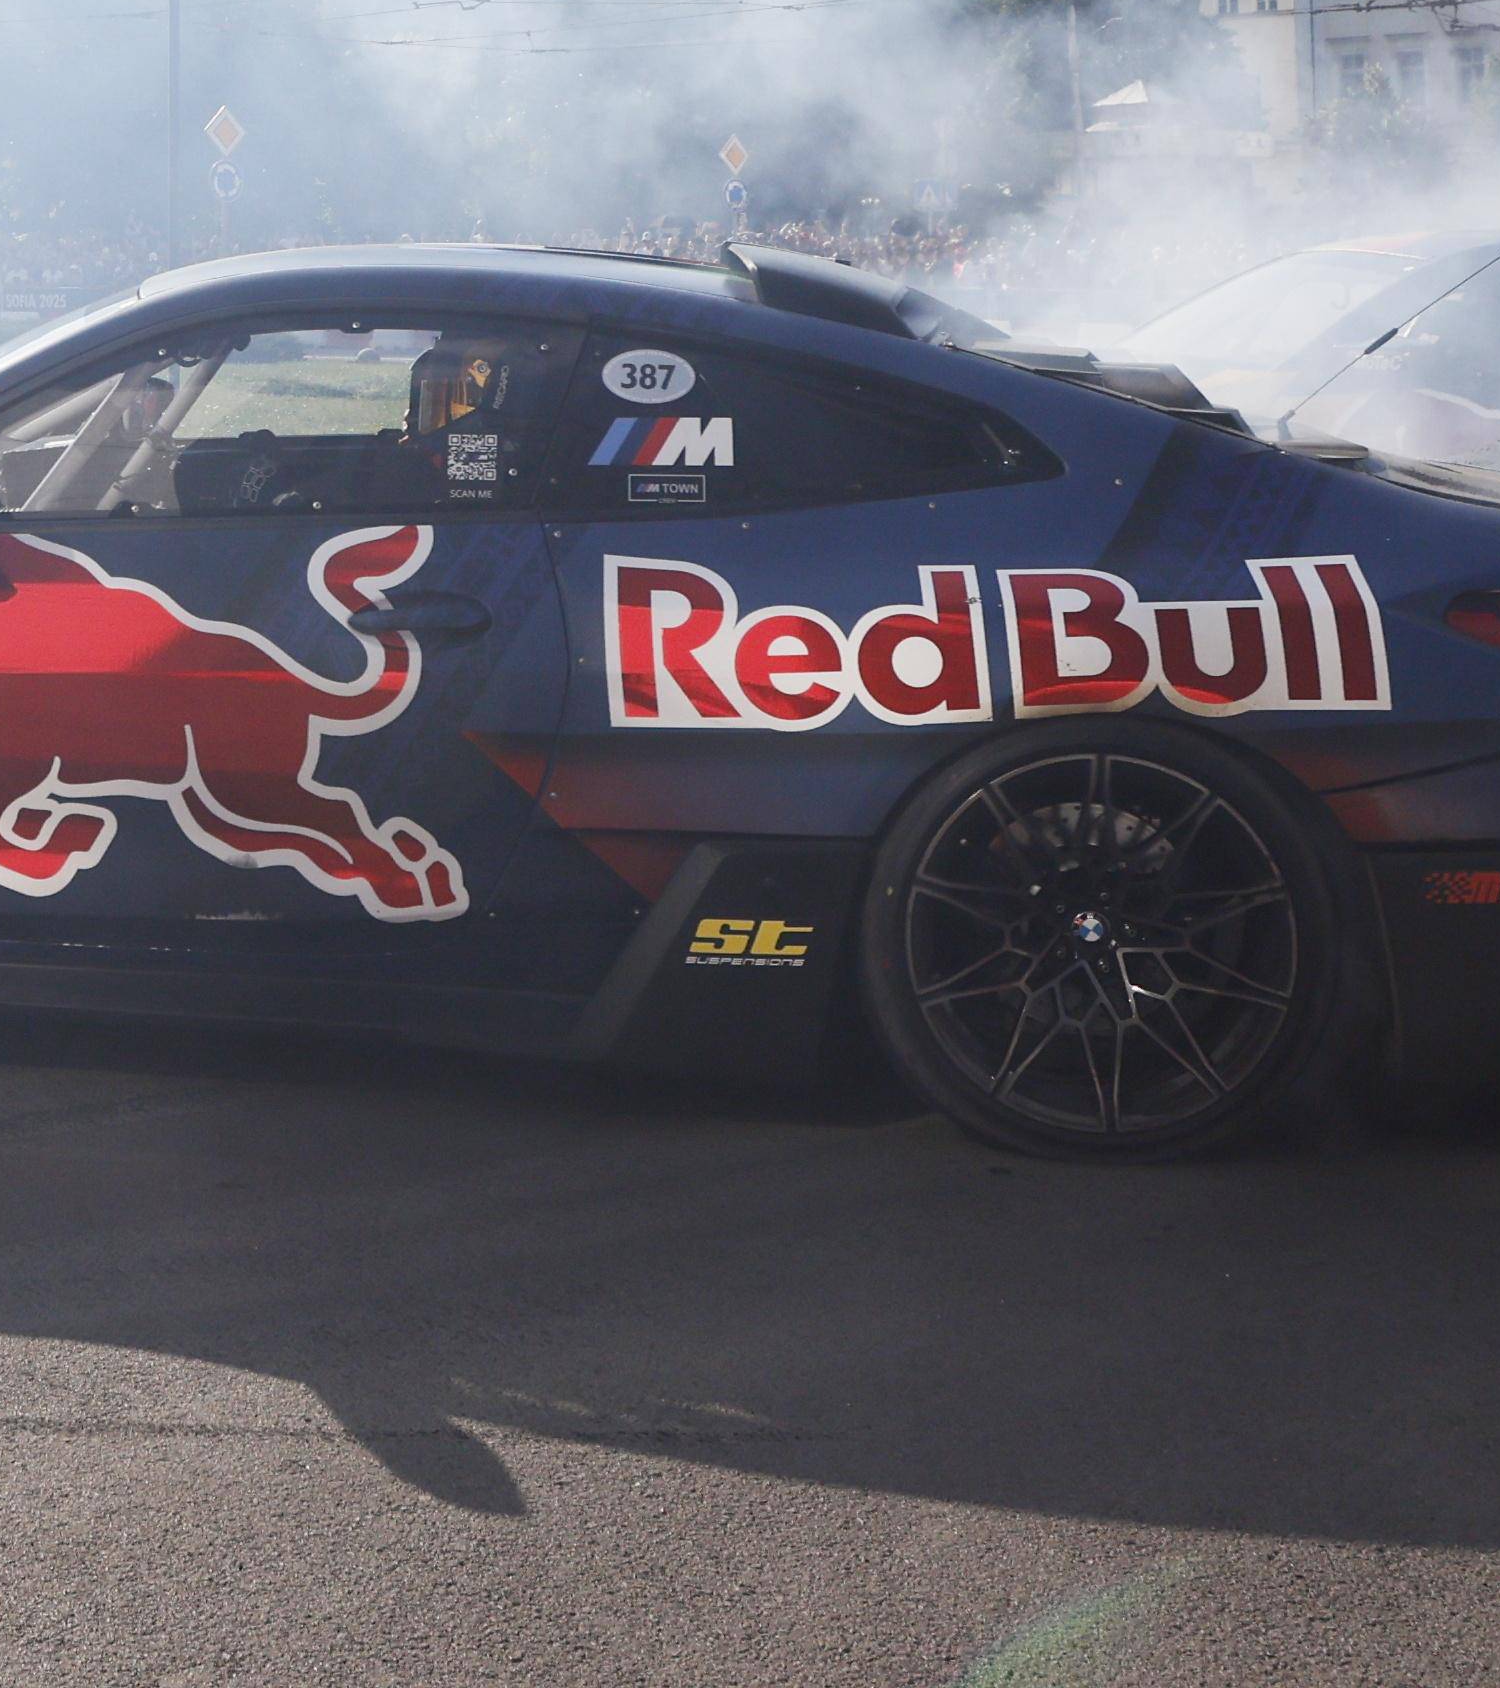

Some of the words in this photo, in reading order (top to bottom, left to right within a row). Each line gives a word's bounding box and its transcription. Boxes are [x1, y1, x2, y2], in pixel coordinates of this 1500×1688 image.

[5, 293, 35, 309] SOFIA
[38, 293, 68, 309] 2025
[619, 363, 677, 391] 387
[449, 489, 475, 499] SCAN
[477, 489, 493, 499] ME
[661, 483, 699, 494] TOWN
[608, 558, 989, 728] Red
[1003, 559, 1387, 713] Bull
